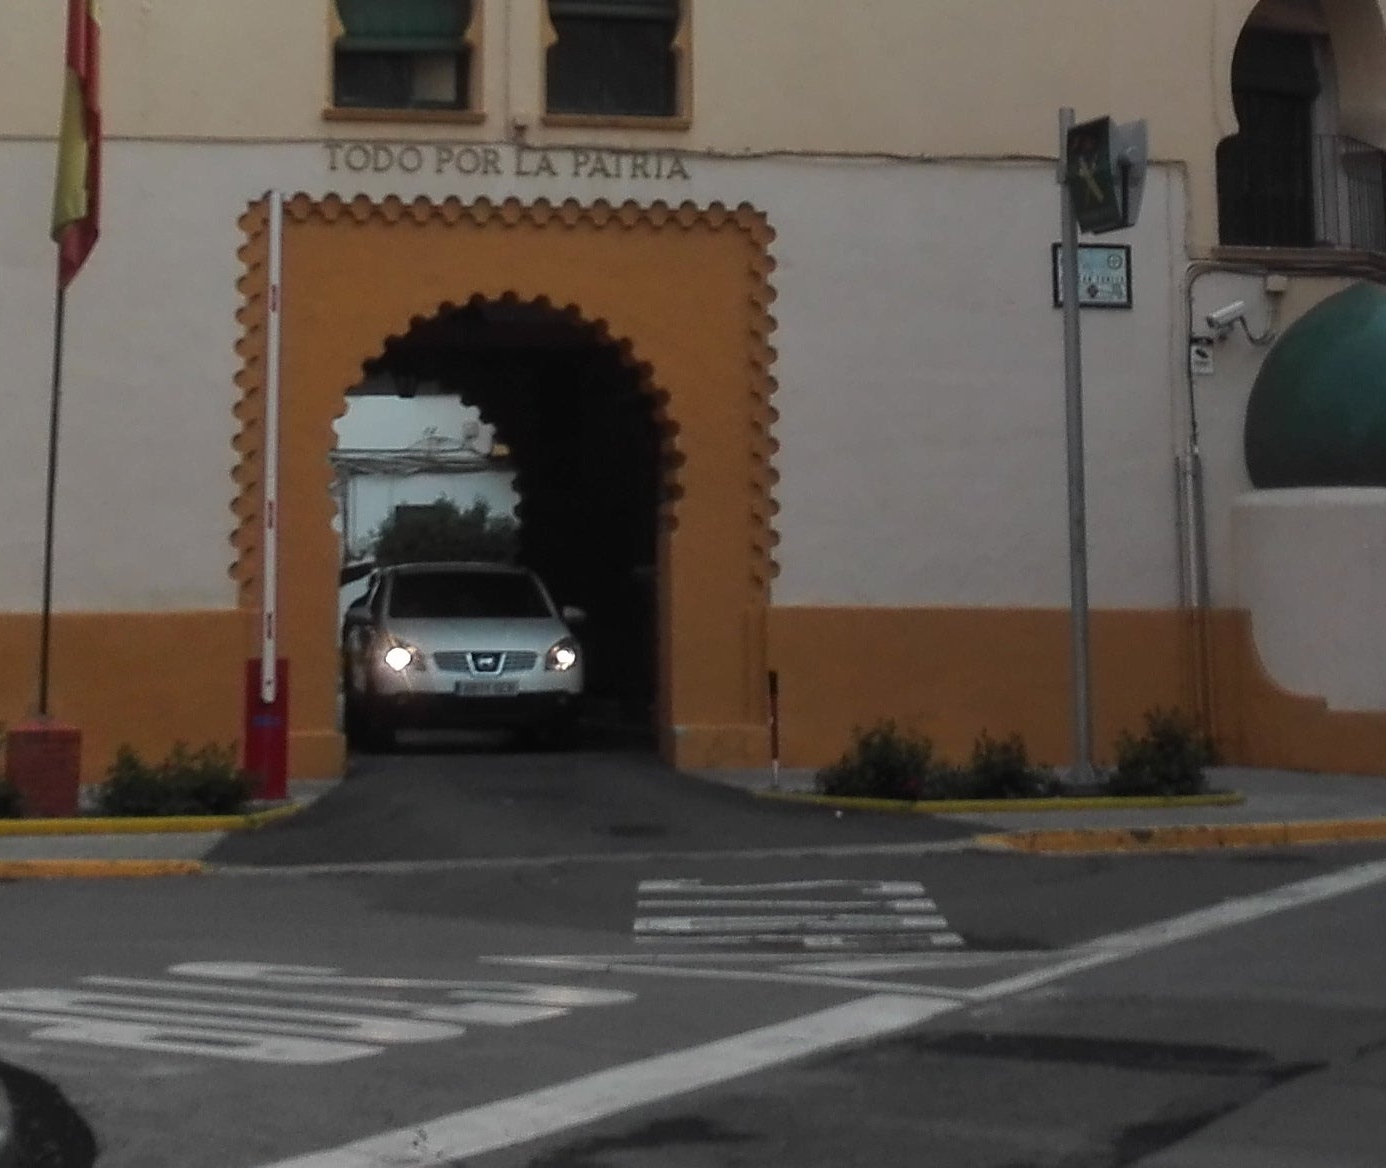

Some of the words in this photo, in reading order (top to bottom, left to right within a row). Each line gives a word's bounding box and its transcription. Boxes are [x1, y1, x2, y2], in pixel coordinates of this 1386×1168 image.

[323, 143, 423, 172] TODO
[435, 146, 503, 174] POR
[515, 148, 558, 178] LA
[570, 150, 691, 180] PATRIA
